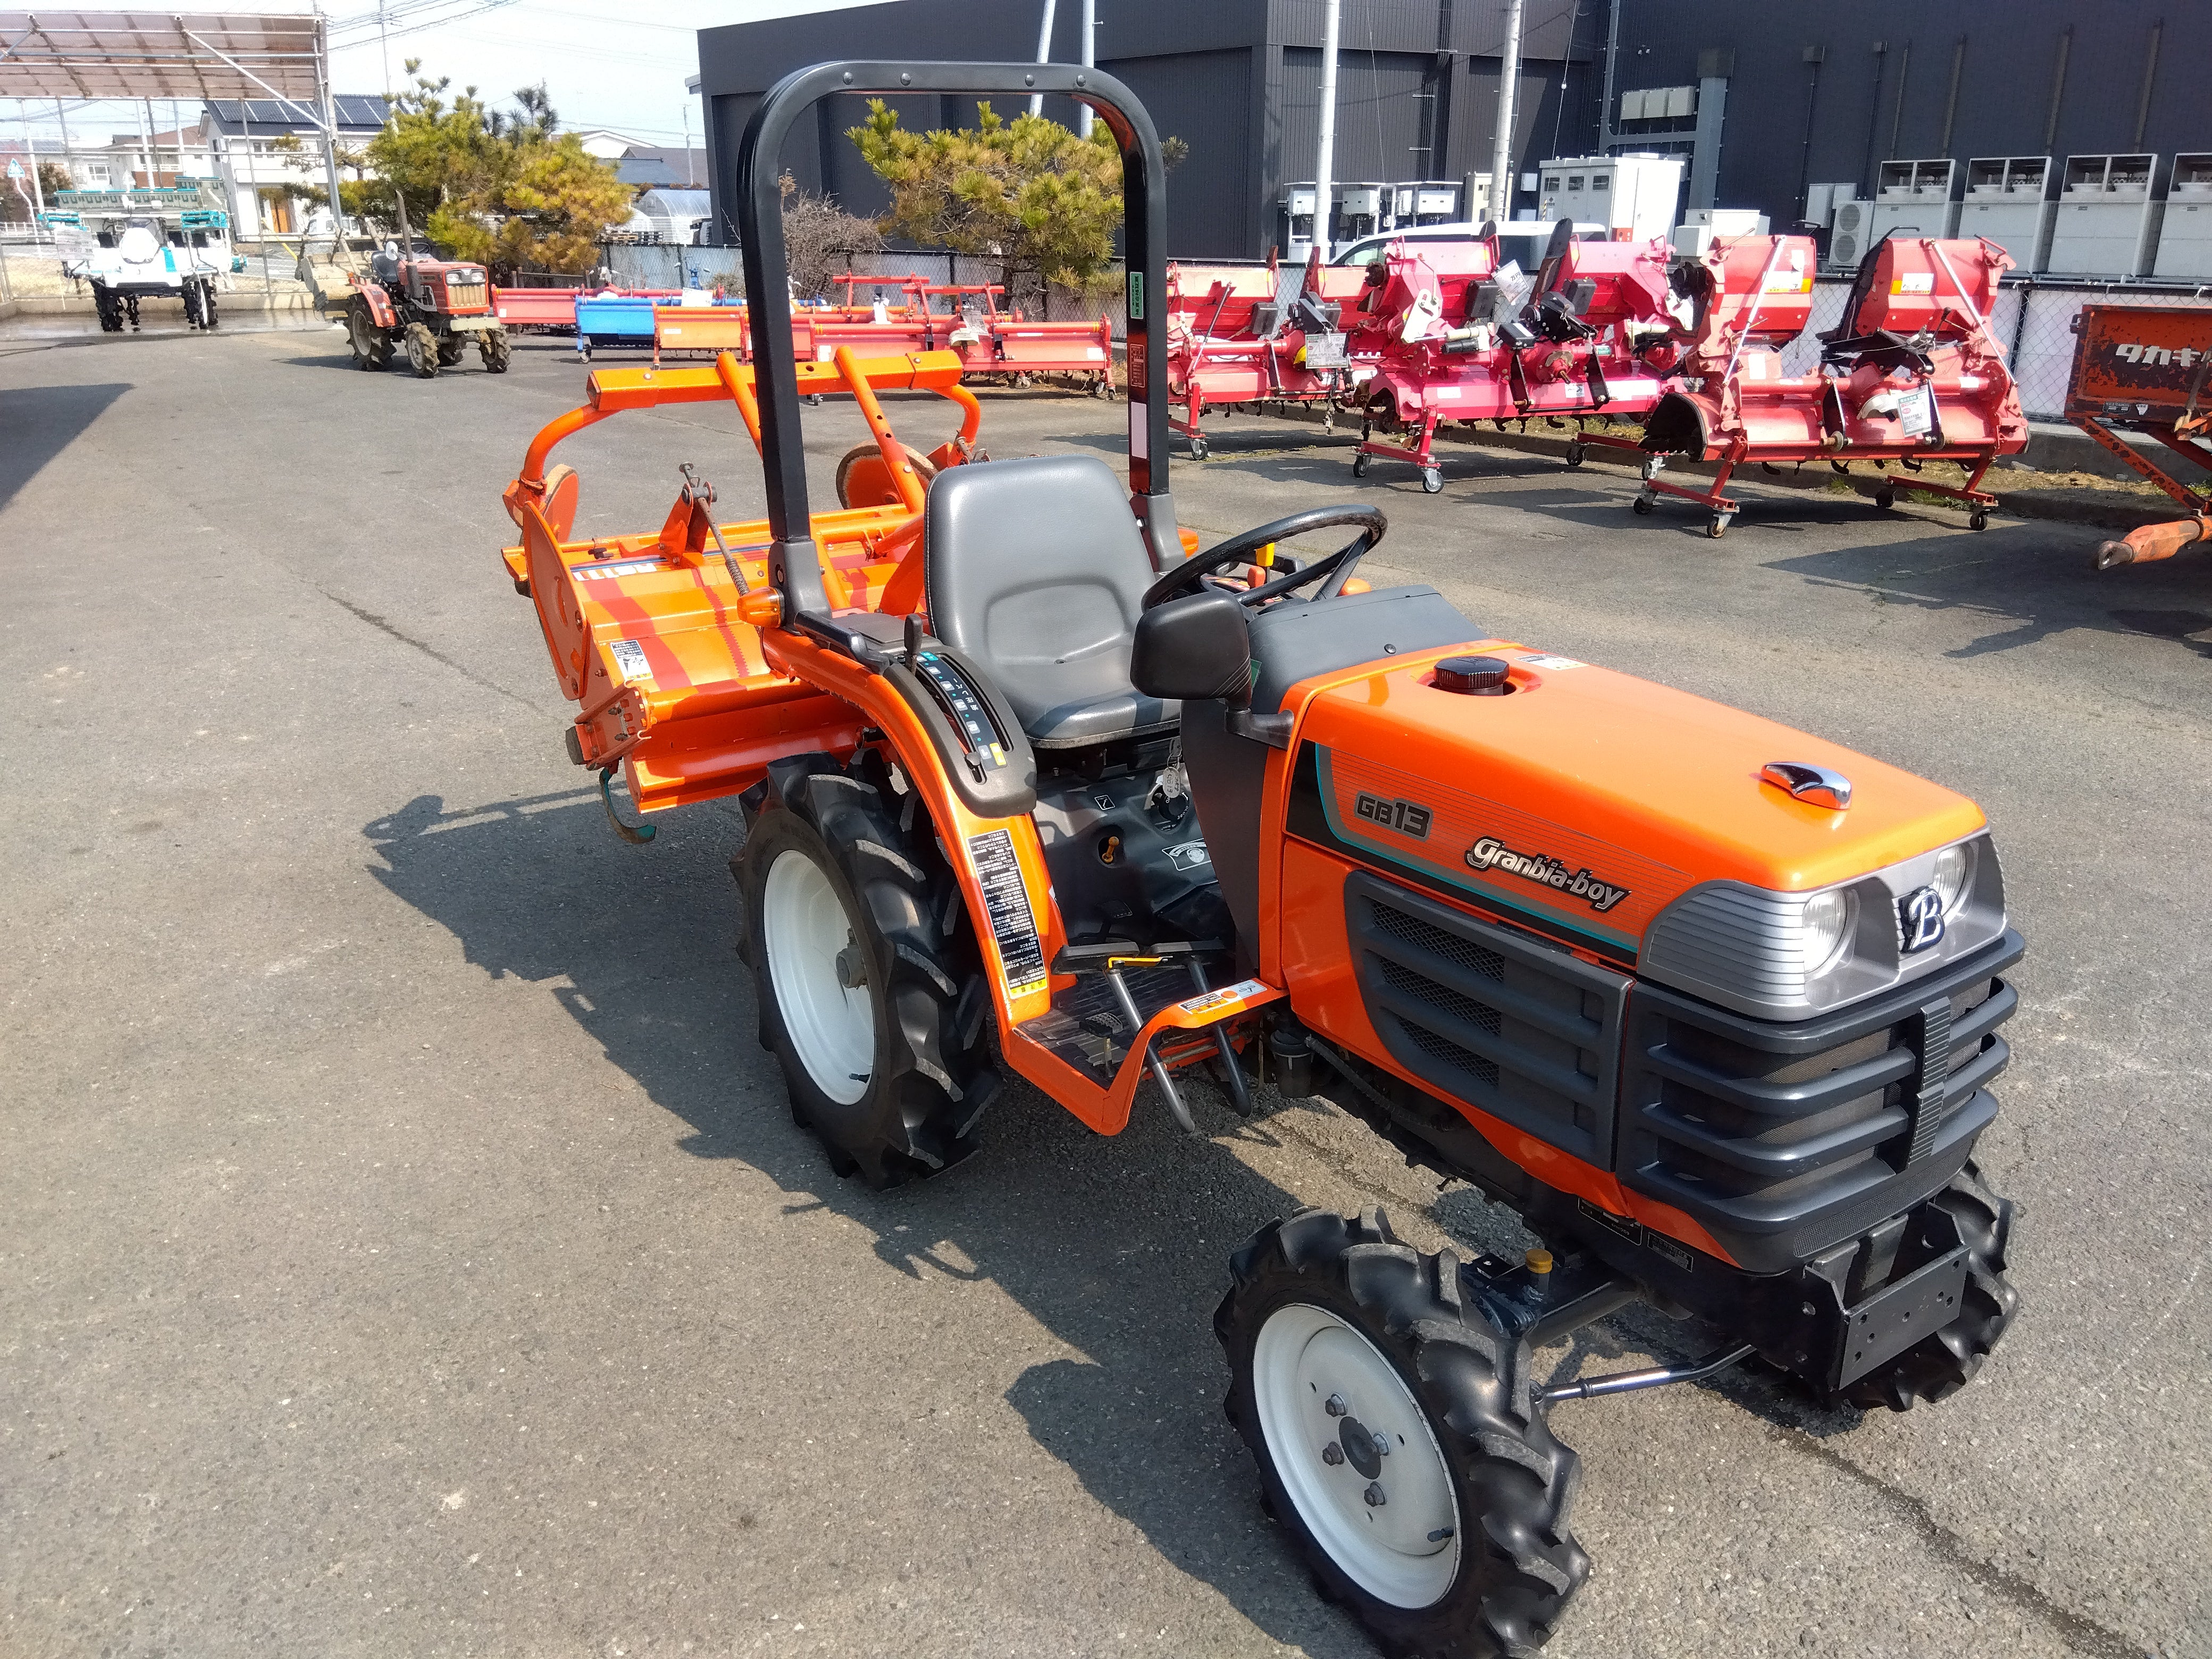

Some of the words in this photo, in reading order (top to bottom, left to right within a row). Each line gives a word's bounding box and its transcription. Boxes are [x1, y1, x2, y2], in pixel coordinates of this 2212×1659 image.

[2116, 343, 2212, 370] タカキ
[1357, 795, 1430, 837] GB13
